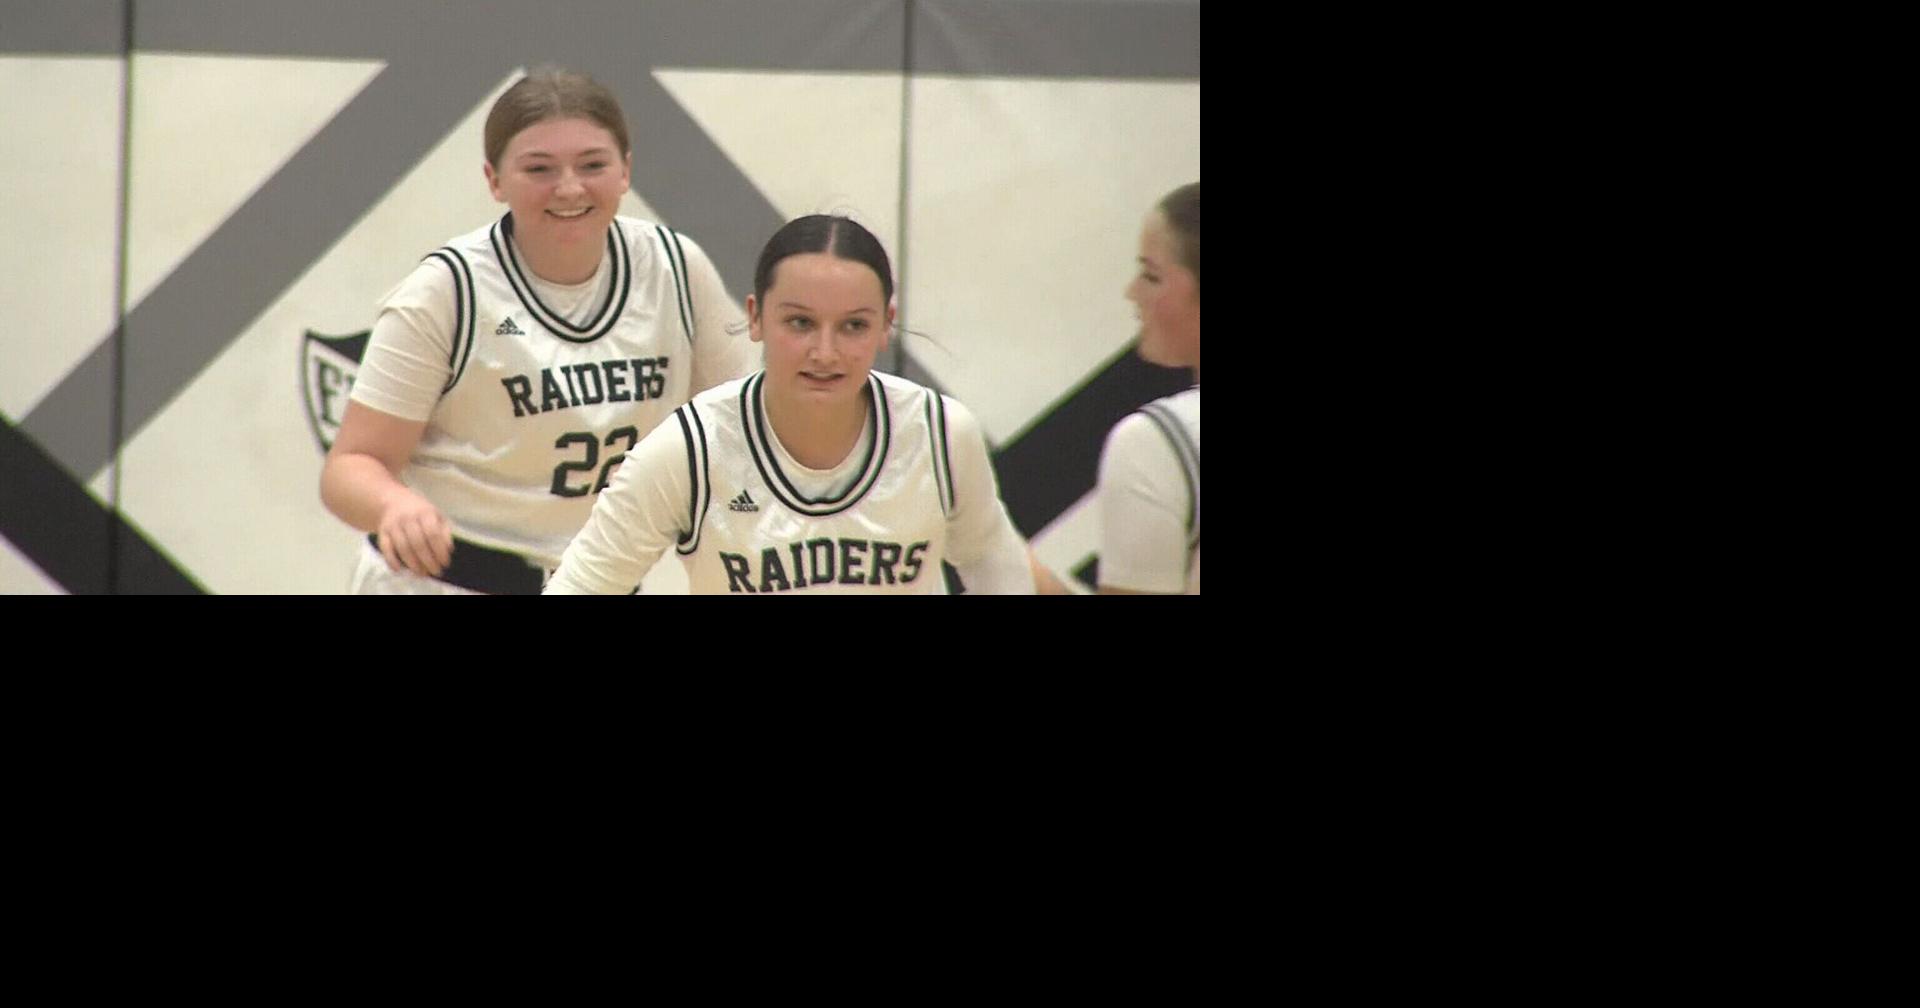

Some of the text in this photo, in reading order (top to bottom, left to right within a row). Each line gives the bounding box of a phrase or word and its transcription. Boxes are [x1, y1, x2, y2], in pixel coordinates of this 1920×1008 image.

[501, 356, 669, 417] RAIDERS
[550, 425, 638, 497] 22
[719, 537, 929, 593] RAIDERS
